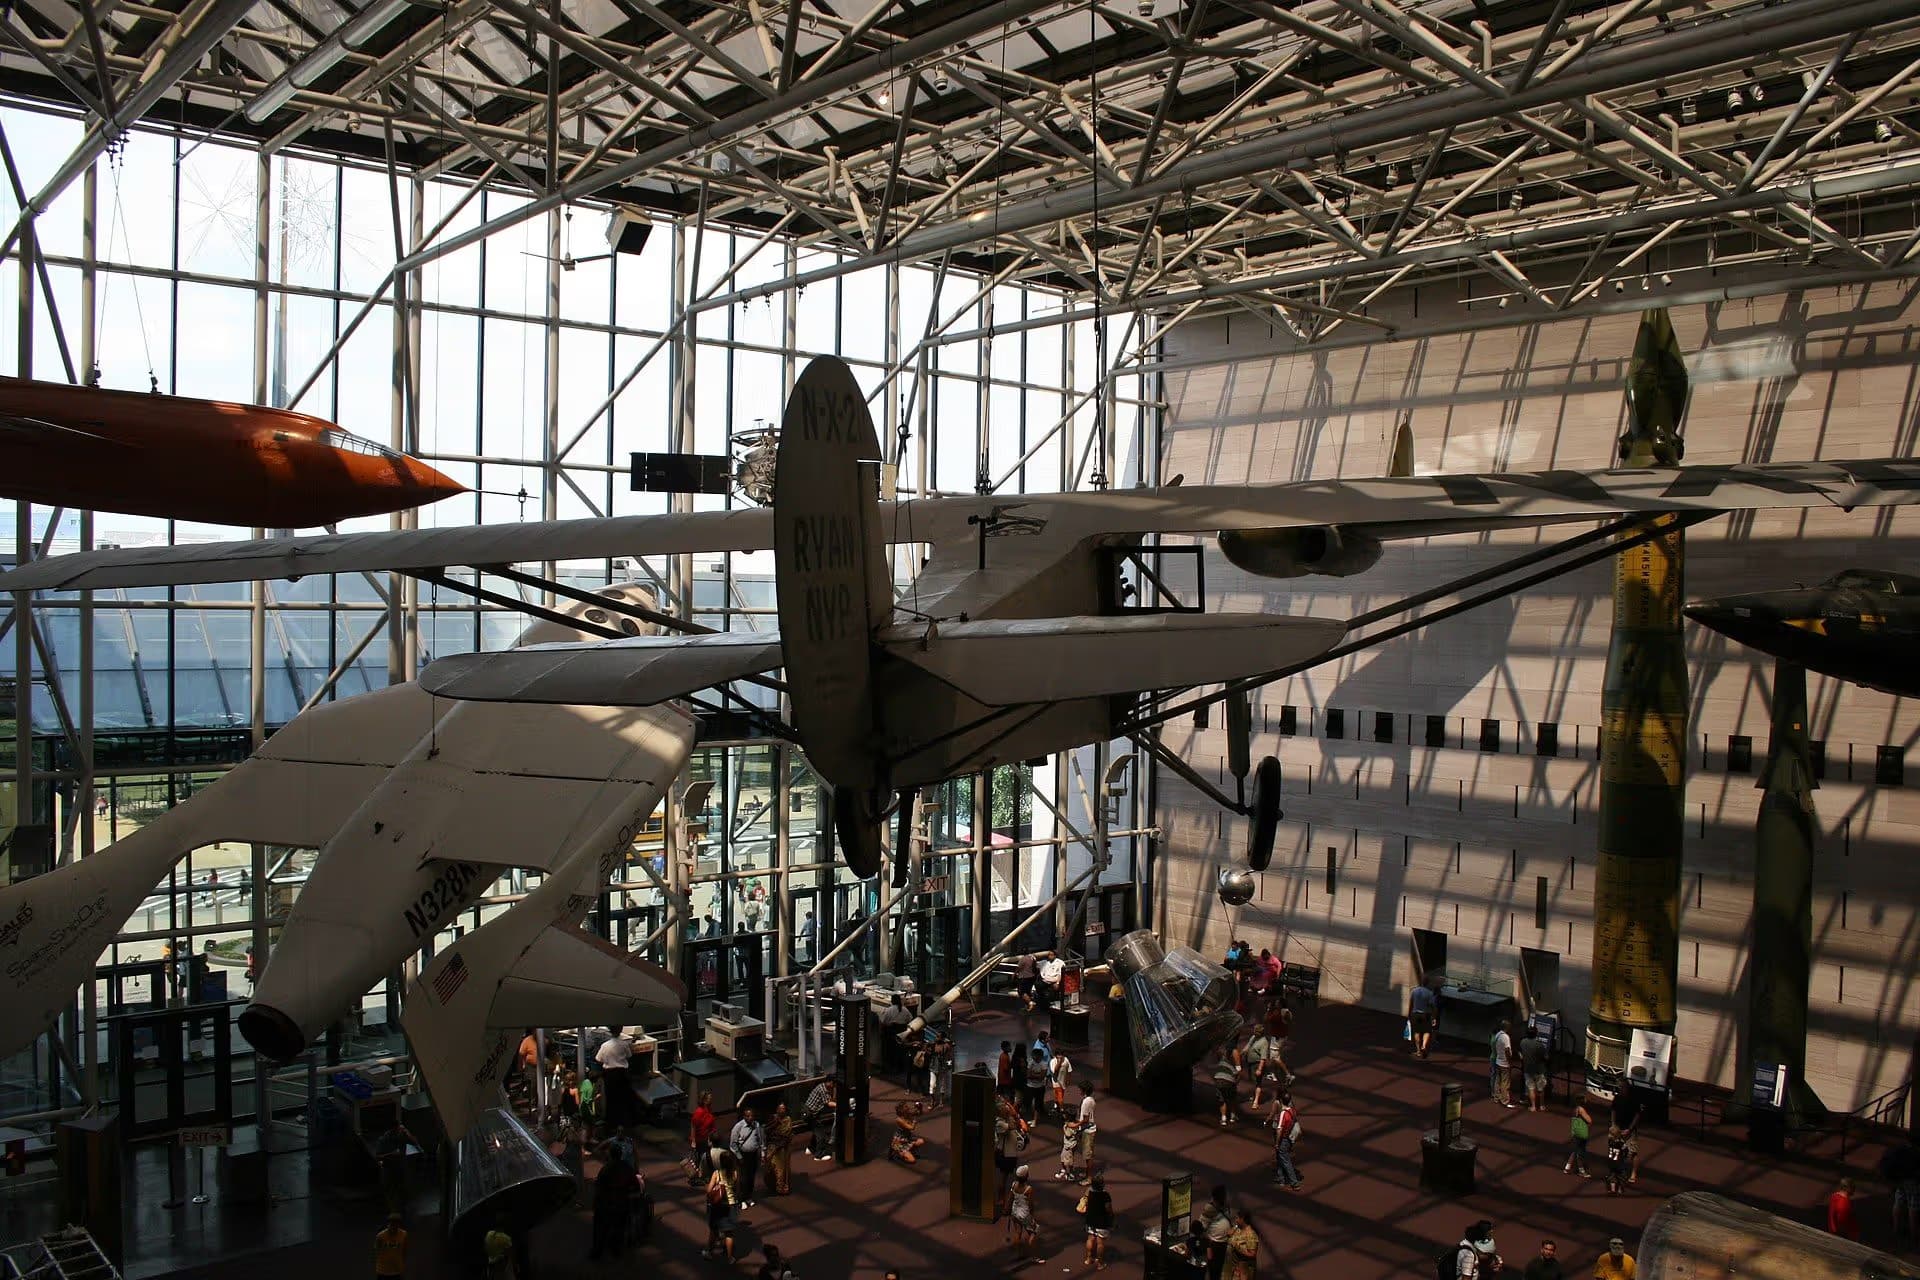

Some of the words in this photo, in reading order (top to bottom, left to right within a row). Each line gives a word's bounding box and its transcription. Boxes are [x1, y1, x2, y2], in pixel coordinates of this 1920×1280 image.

[793, 516, 855, 571] RYAN
[804, 583, 852, 642] NYP
[921, 876, 948, 892] EXIT
[183, 1131, 209, 1145] EXIT
